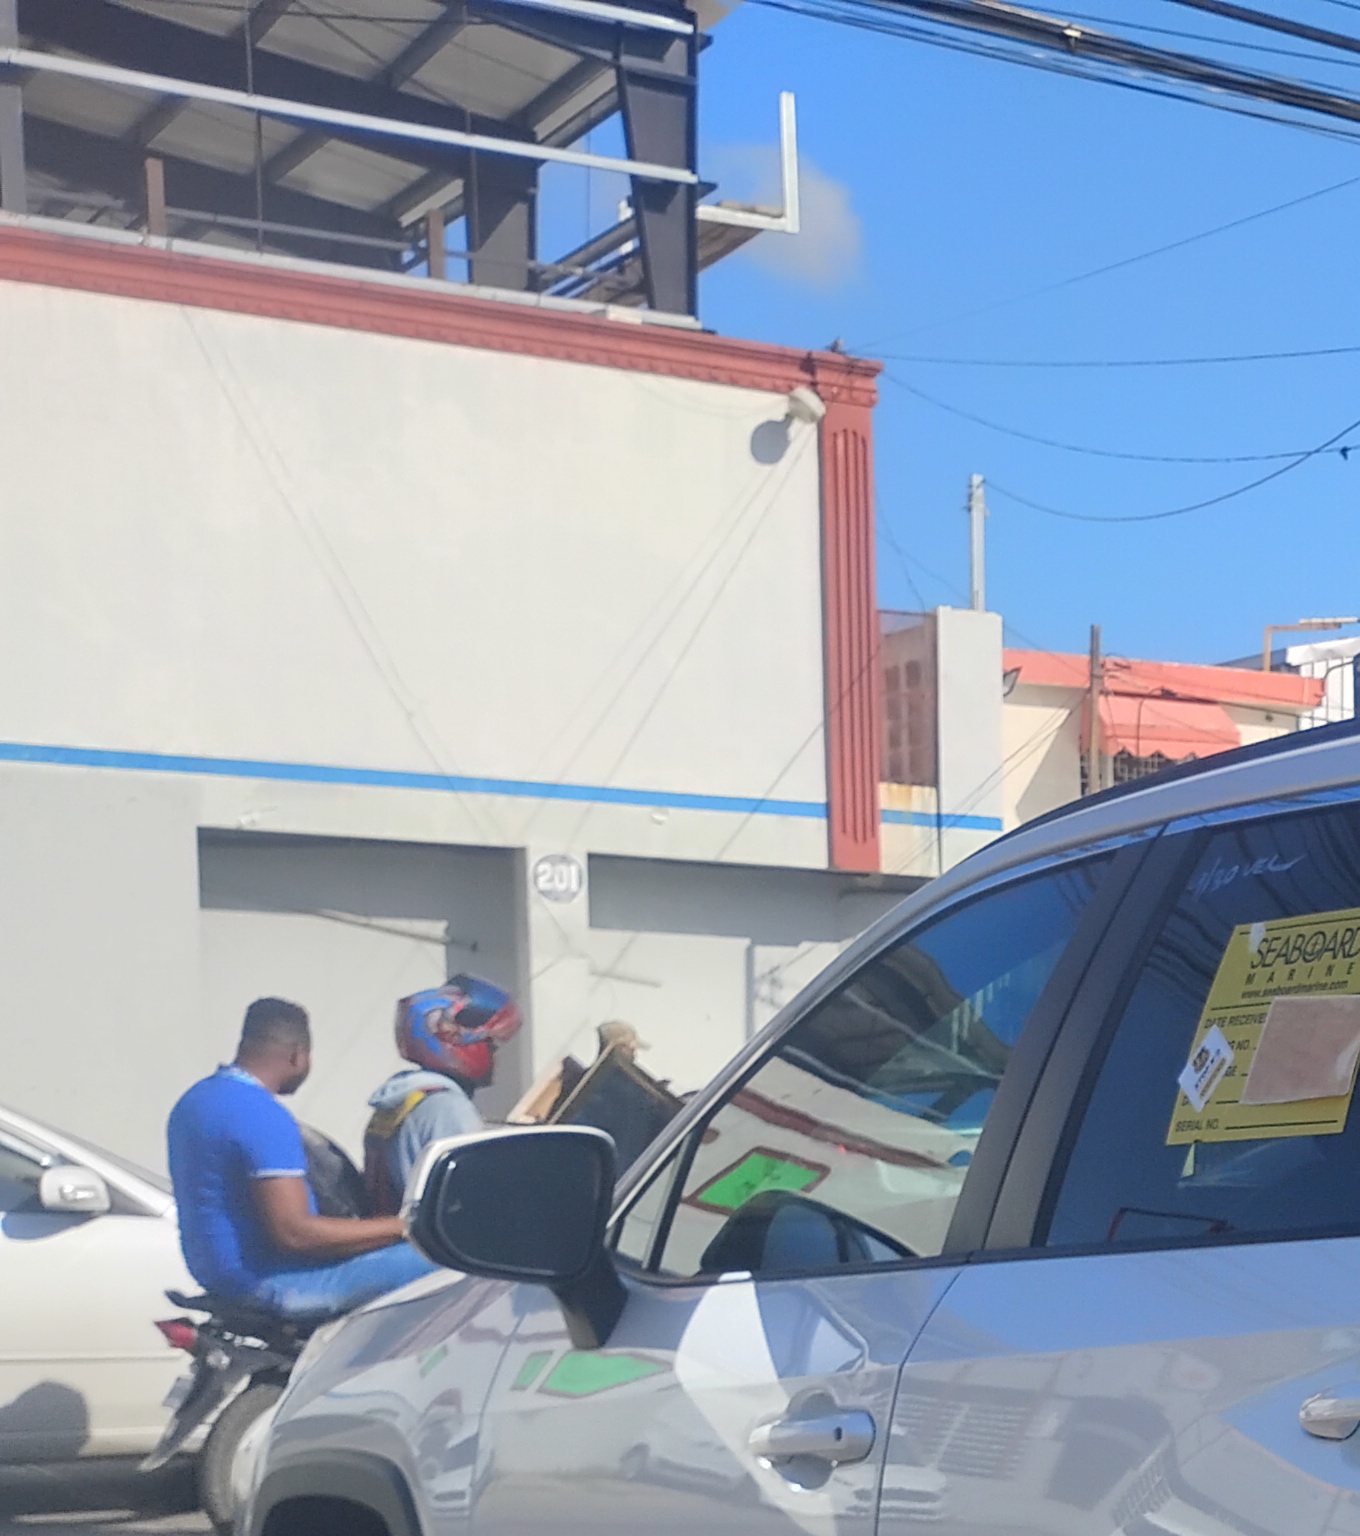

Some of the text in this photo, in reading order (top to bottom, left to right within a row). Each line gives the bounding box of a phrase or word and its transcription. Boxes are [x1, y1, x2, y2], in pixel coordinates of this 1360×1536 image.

[537, 861, 579, 893] 201
[1245, 961, 1356, 986] MARINE
[1241, 979, 1349, 999] www.seaboardmarine.com
[1228, 1012, 1268, 1026] RECEIVE
[1176, 1119, 1202, 1132] SERIAL
